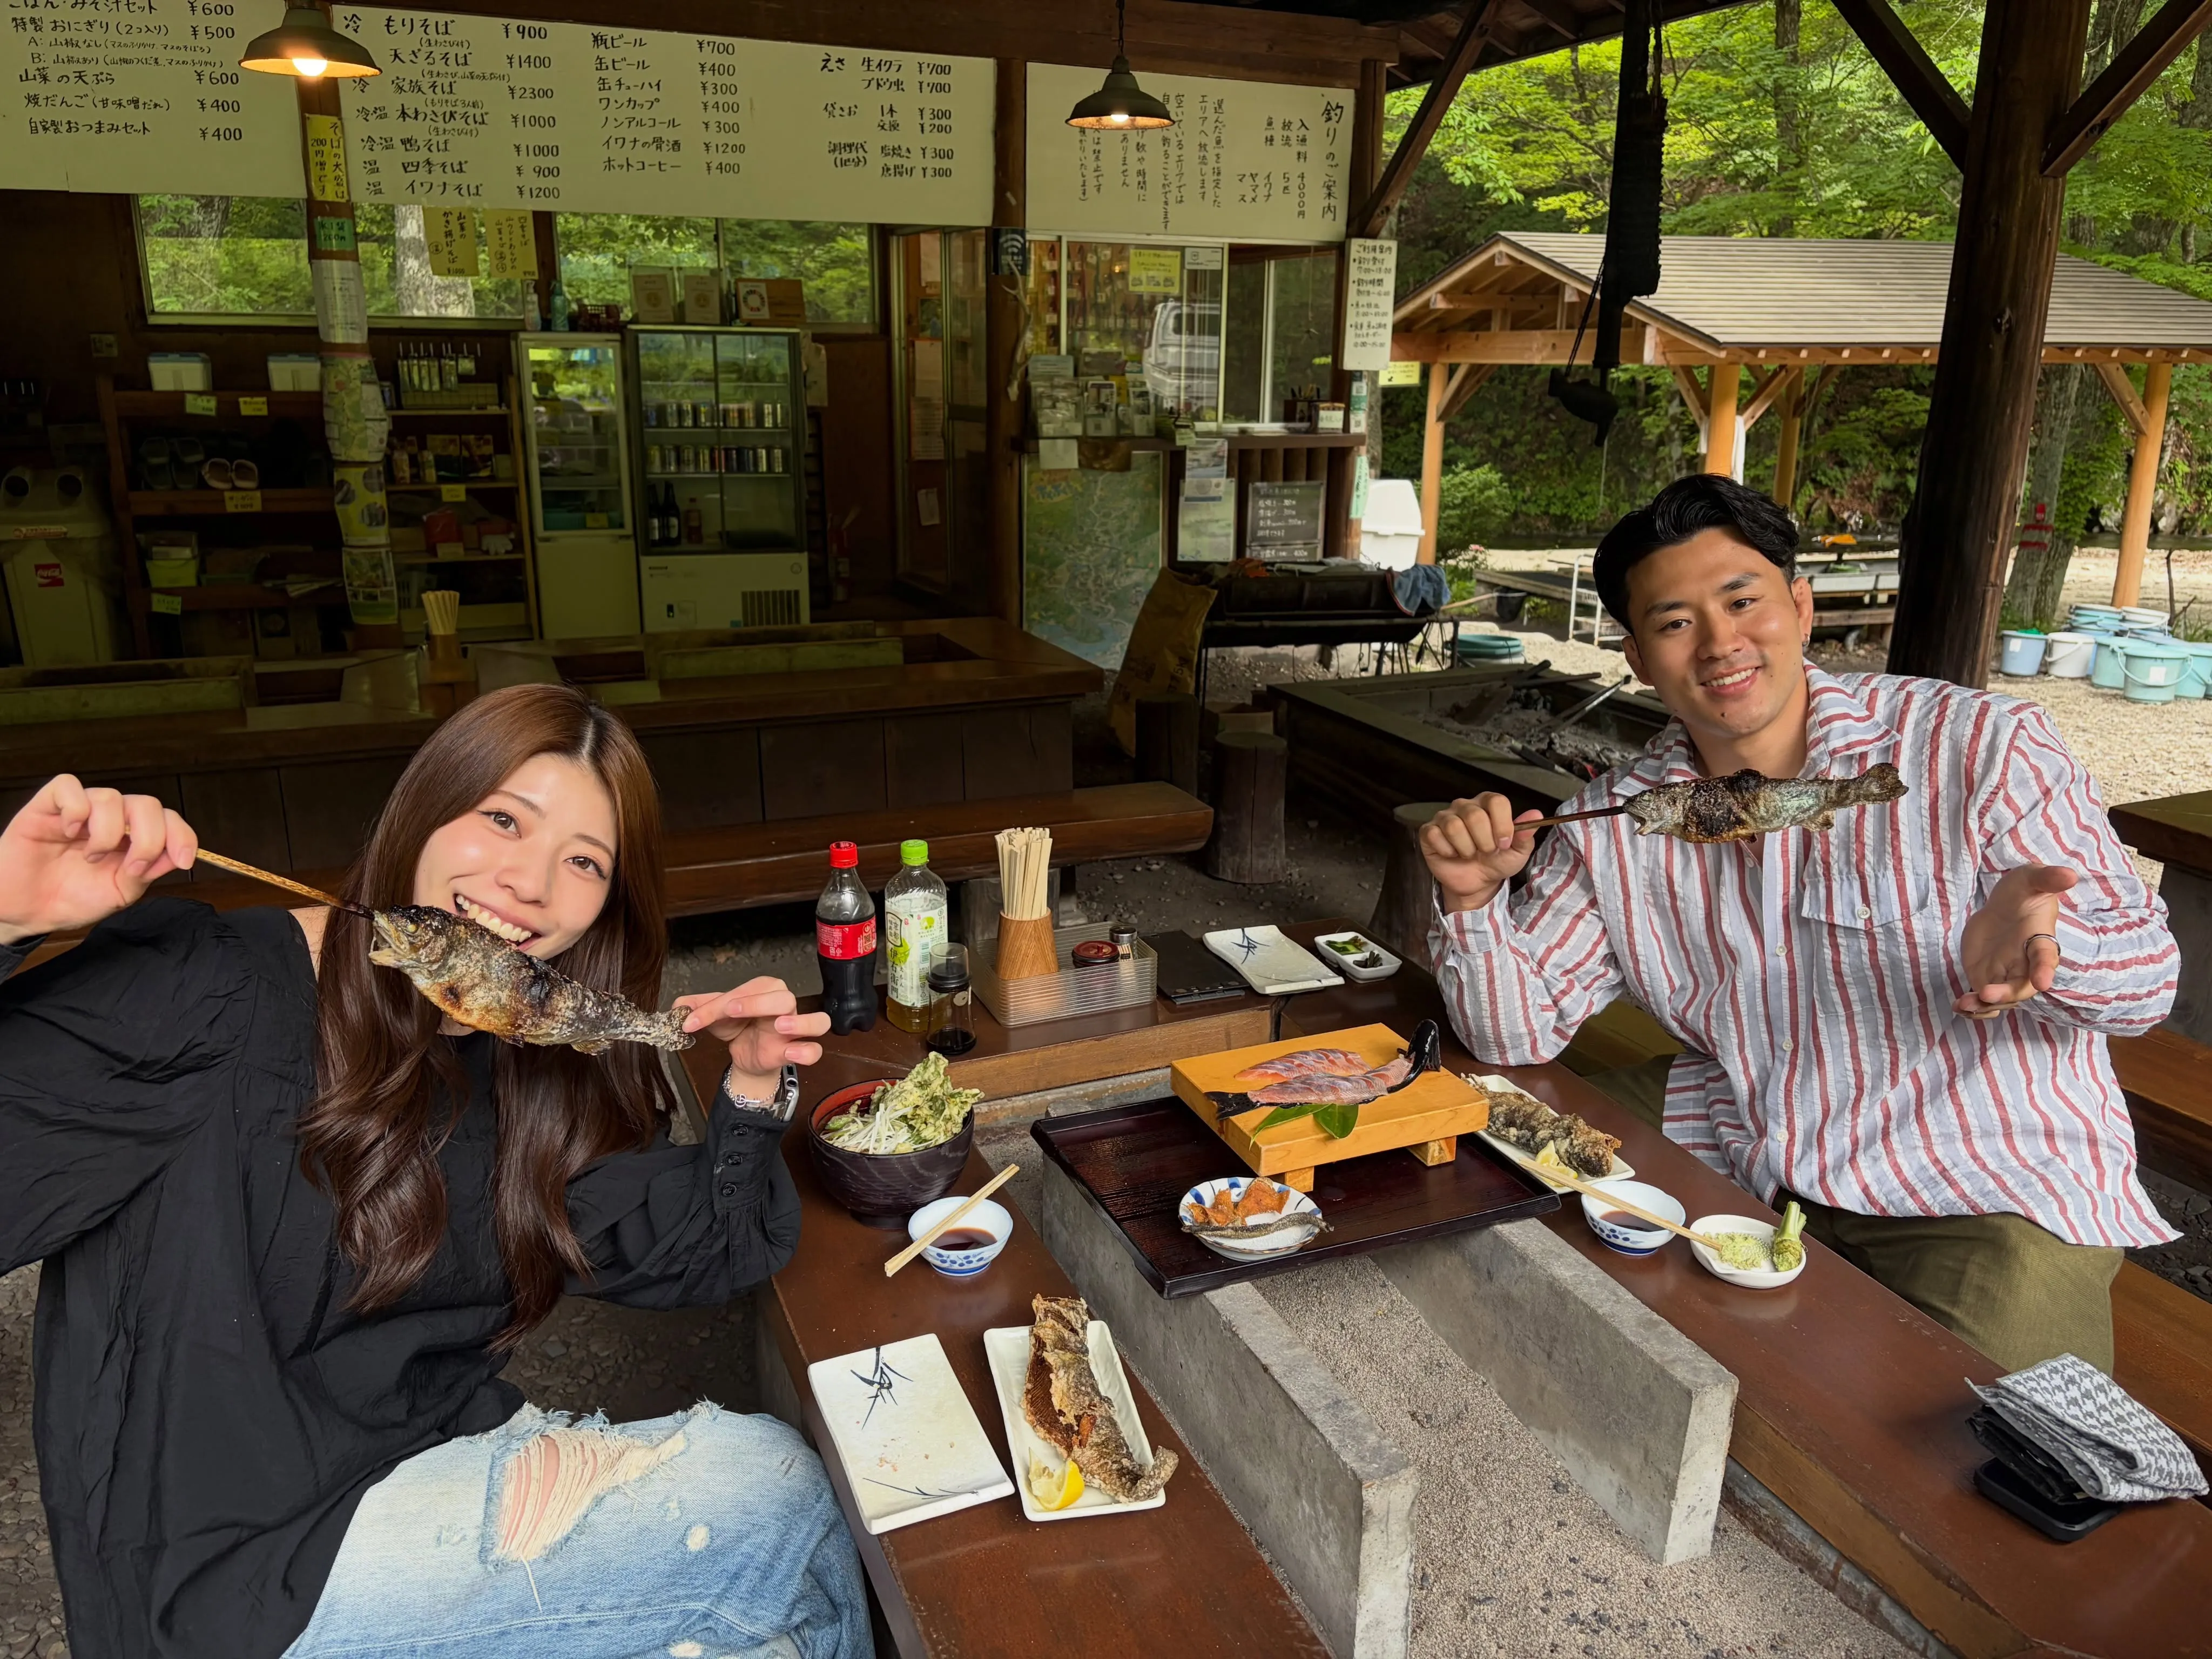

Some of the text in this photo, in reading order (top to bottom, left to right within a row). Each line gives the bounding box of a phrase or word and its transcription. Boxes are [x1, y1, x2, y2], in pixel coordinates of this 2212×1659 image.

[187, 0, 234, 16] ¥600
[190, 25, 235, 41] ¥500
[343, 13, 548, 39] 冷 もりそば ¥900
[591, 31, 735, 56] 瓶ビール ¥700
[389, 47, 551, 69] 天ざるそば ¥1400
[594, 55, 736, 77] 缶ビール ¥400
[820, 52, 952, 76] えさ 生イクラ ¥700
[19, 66, 239, 85] 山菜の天ぷら ¥600
[861, 77, 951, 94] ブドウ虫 ¥700
[391, 75, 457, 96] 家族そば
[508, 85, 554, 100] ¥2300
[597, 76, 738, 96] 缶チューハイ ¥300
[197, 98, 240, 113] ¥400
[599, 97, 740, 113] ワンカップ ¥400
[822, 102, 952, 121] 貸さお 1本 ¥300
[394, 103, 490, 127] 本わさびそば
[510, 113, 556, 129] ¥1000
[601, 116, 740, 134] ノンアルコール ¥300
[29, 117, 242, 141] 自家製おつまみセット ¥400
[877, 119, 952, 134] 交換 ¥200
[400, 135, 450, 153] 鴨そば
[513, 144, 559, 157] ¥1000
[602, 135, 746, 154] イワナの骨酒 ¥1200
[828, 141, 954, 160] 調理代 塩焼き ¥300
[363, 158, 560, 178] 温 四季そば ¥900
[603, 156, 740, 176] ホットコーヒー ¥400
[1321, 100, 1345, 221] 釣りのご案内
[881, 163, 916, 178] 唐揚げ
[921, 166, 952, 179] ¥300
[366, 180, 560, 199] 温 イワナそば ¥1200
[1236, 173, 1247, 204] マス
[1249, 172, 1260, 204] ヤマメ
[1264, 171, 1273, 203] イワナ
[1297, 172, 1307, 219] 4000円
[889, 947, 899, 999] 伊右衛門
